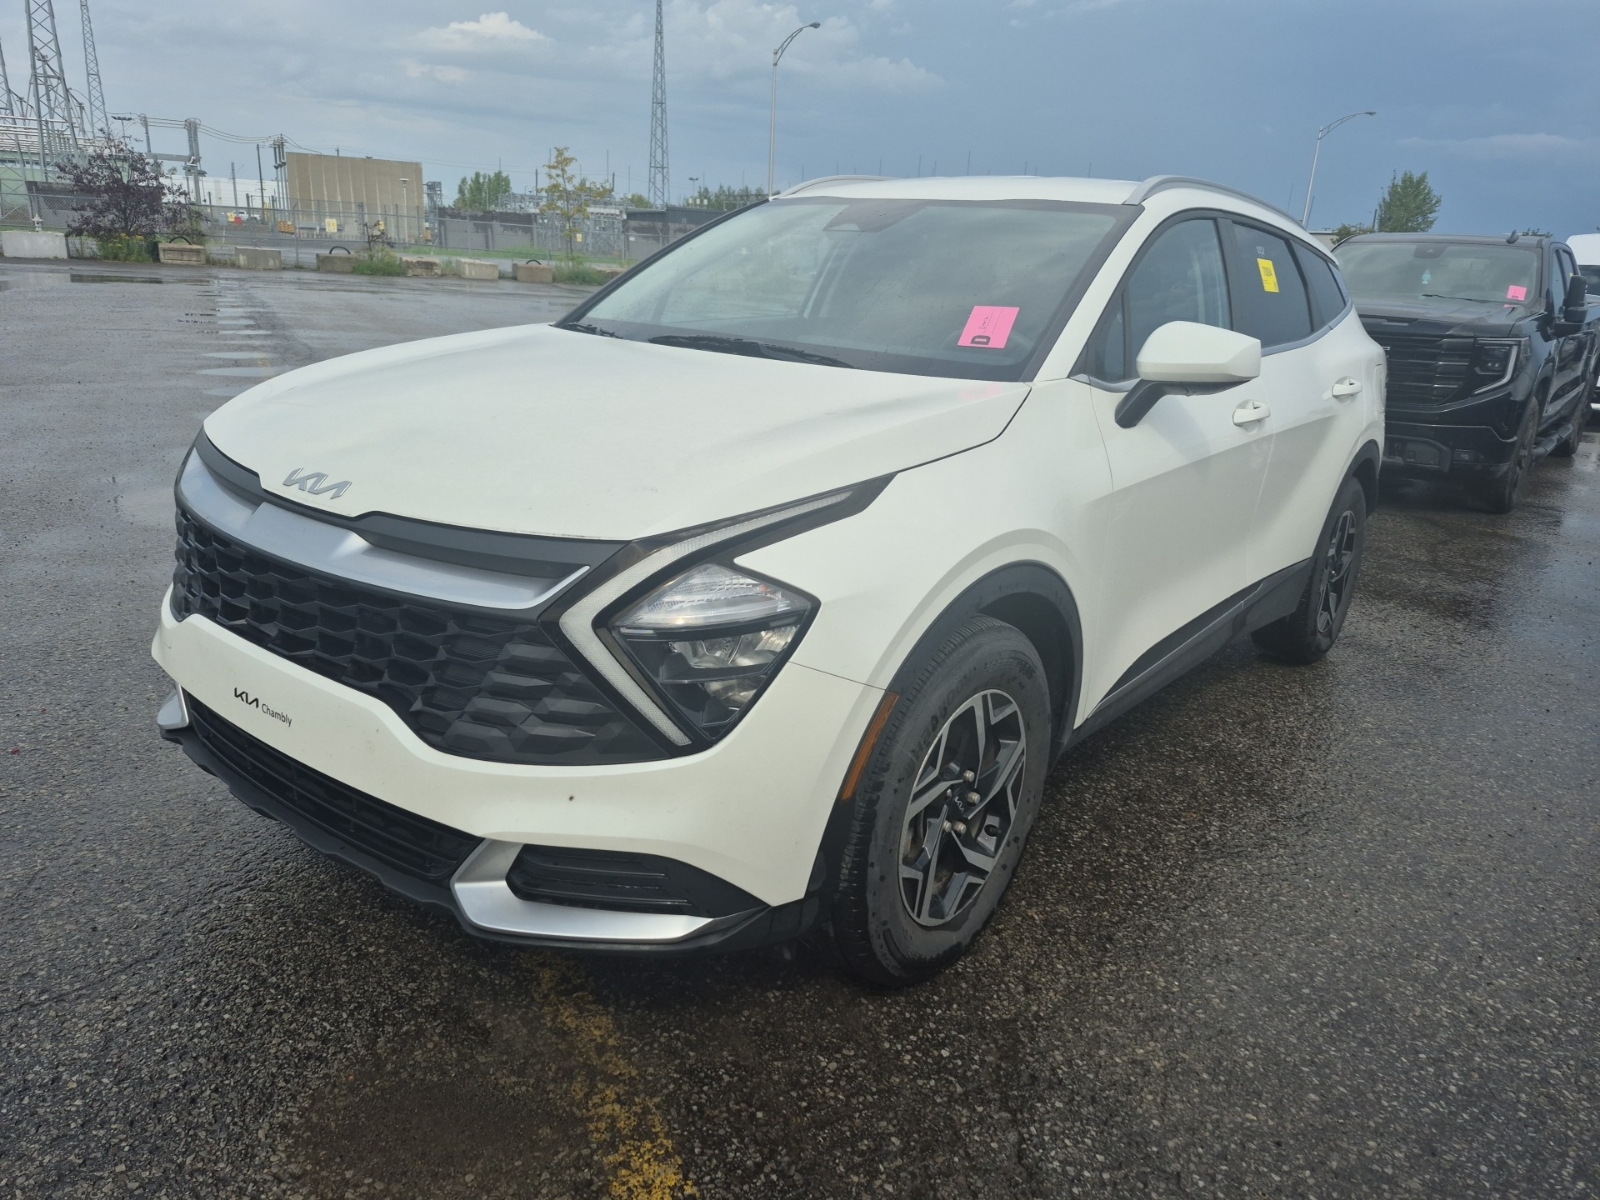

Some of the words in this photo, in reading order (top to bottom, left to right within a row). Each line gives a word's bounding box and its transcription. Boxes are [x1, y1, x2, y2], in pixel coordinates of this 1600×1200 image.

[283, 467, 352, 500] KIA
[234, 687, 259, 709] KIA
[261, 703, 292, 728] Chambly
